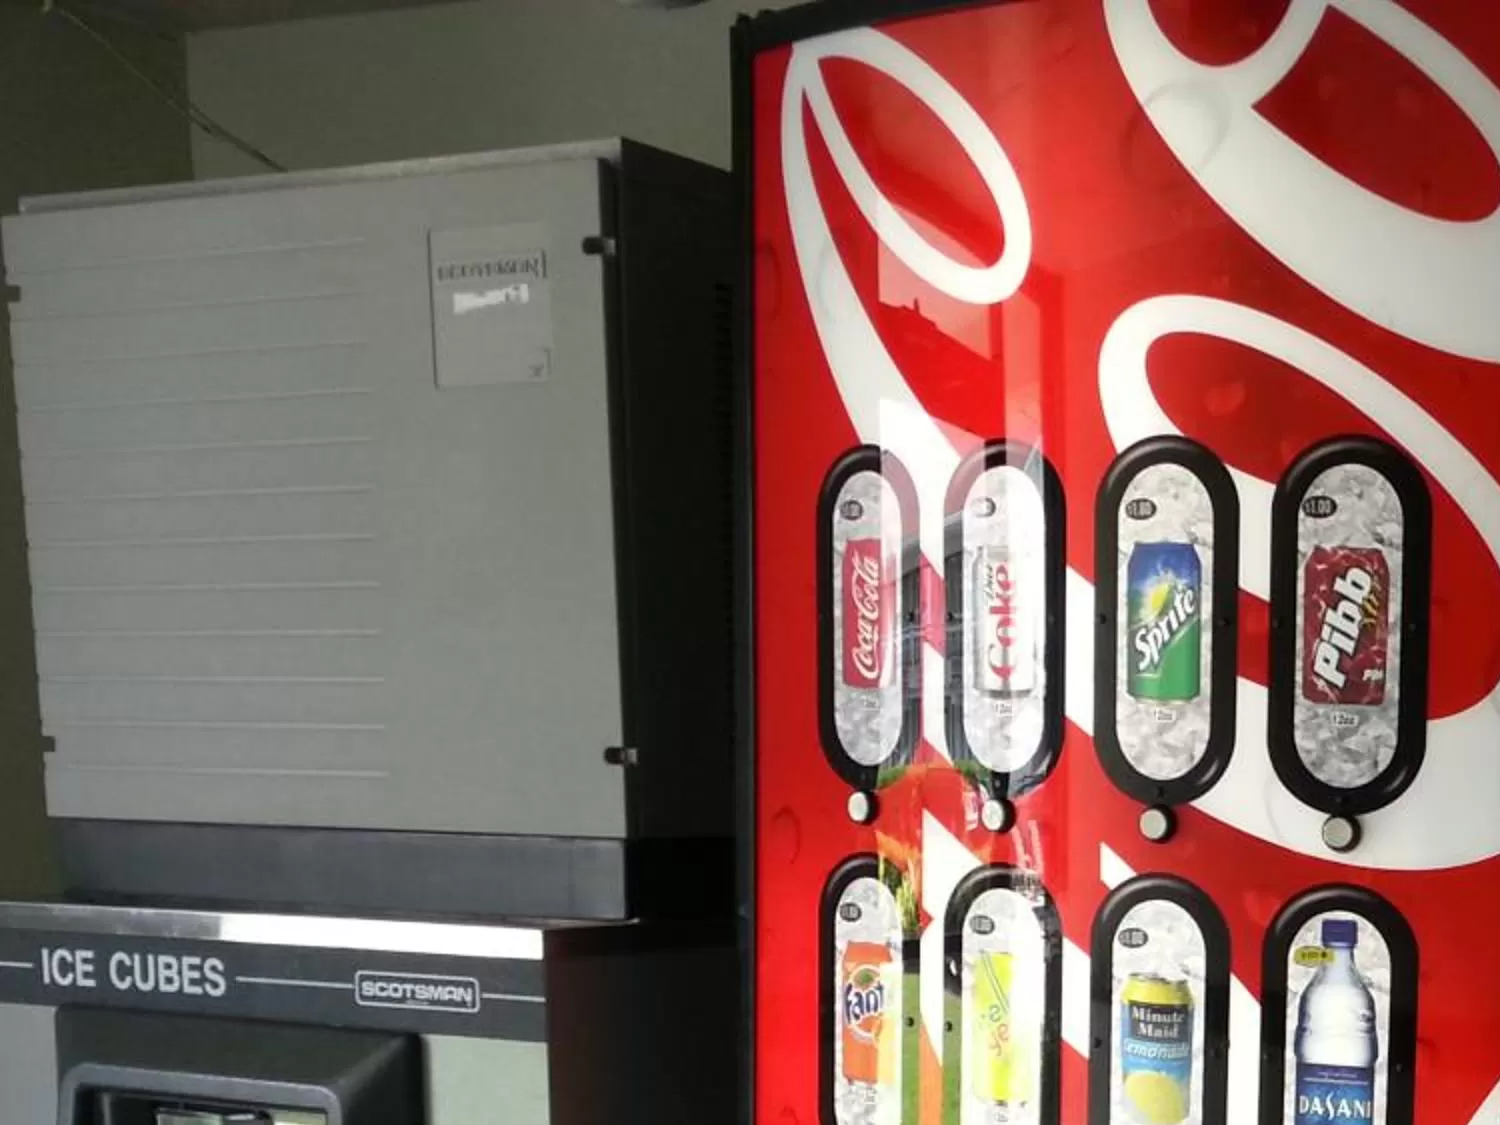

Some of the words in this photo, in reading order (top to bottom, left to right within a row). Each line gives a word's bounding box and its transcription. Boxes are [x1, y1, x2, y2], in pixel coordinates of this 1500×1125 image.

[1135, 587, 1197, 672] Sprite
[1312, 566, 1372, 689] Pibb
[40, 946, 98, 988] ICE
[108, 950, 228, 998] CUBES
[361, 980, 473, 1005] SCOTSMAN
[844, 981, 887, 1023] Fant
[1131, 1005, 1185, 1023] Minute
[1138, 1021, 1180, 1038] Maid
[1299, 1091, 1371, 1121] DASANI
